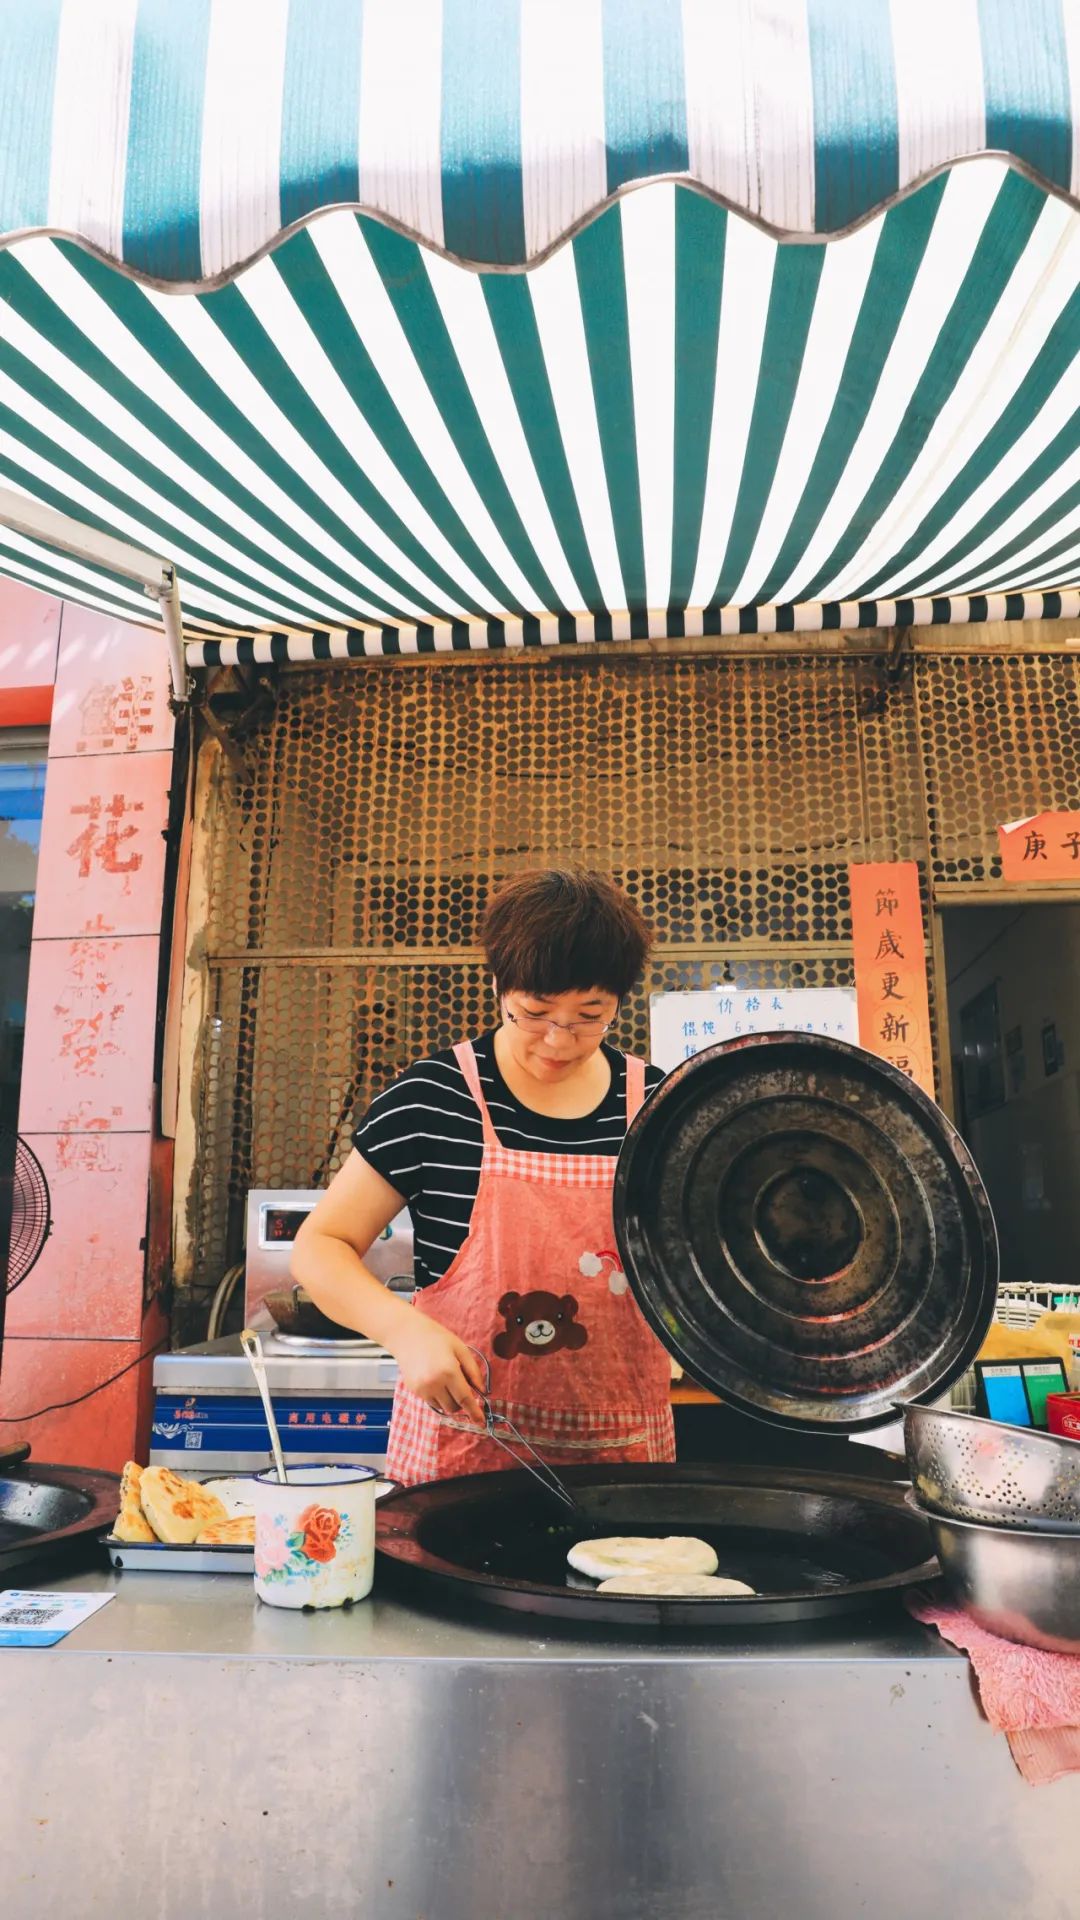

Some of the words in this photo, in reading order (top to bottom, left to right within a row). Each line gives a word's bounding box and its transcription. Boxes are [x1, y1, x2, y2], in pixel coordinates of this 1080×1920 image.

[1022, 830, 1080, 861] 庚子
[717, 997, 784, 1014] 价格表
